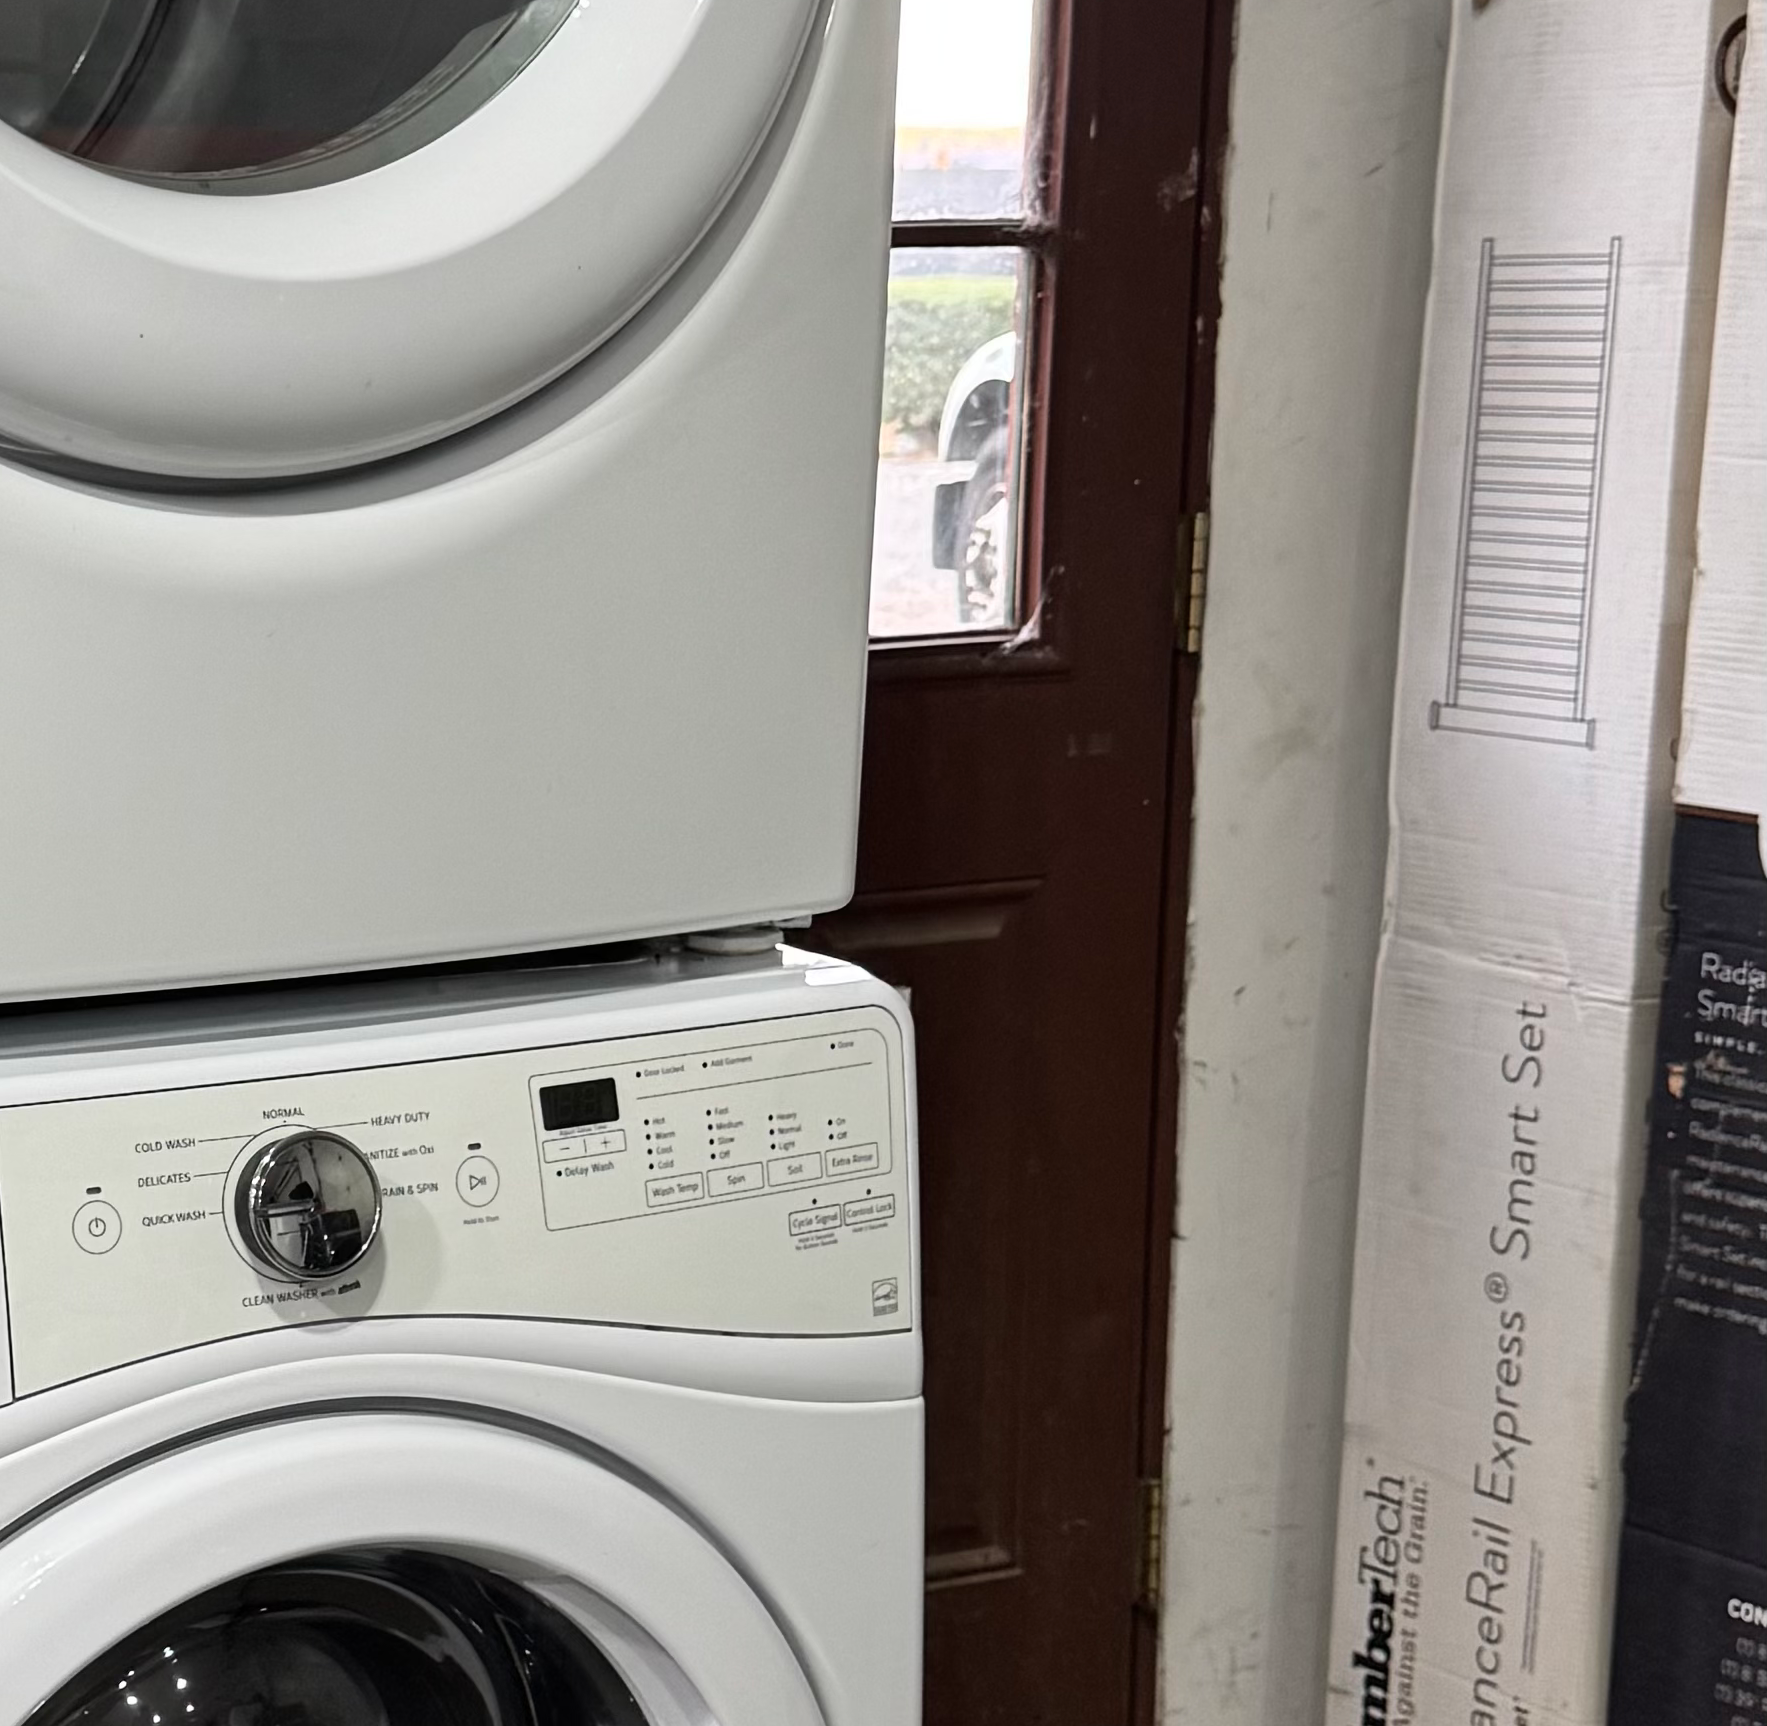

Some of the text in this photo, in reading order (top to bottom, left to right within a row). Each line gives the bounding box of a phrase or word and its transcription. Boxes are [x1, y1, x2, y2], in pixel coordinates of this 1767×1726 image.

[1502, 1000, 1547, 1088] Set
[262, 1107, 304, 1120] NORMAL
[371, 1112, 430, 1126] HEAVY DUTY
[135, 1138, 196, 1153] COLD WASH
[364, 1148, 399, 1160] ANITIZE
[138, 1173, 191, 1188] DELICATES
[1490, 1104, 1538, 1261] Smart
[382, 1186, 404, 1197] RAIN
[417, 1183, 439, 1193] SPIN
[142, 1211, 206, 1226] QUICK WASH
[242, 1289, 318, 1307] CLEAN WASHER
[1401, 1573, 1422, 1620] the
